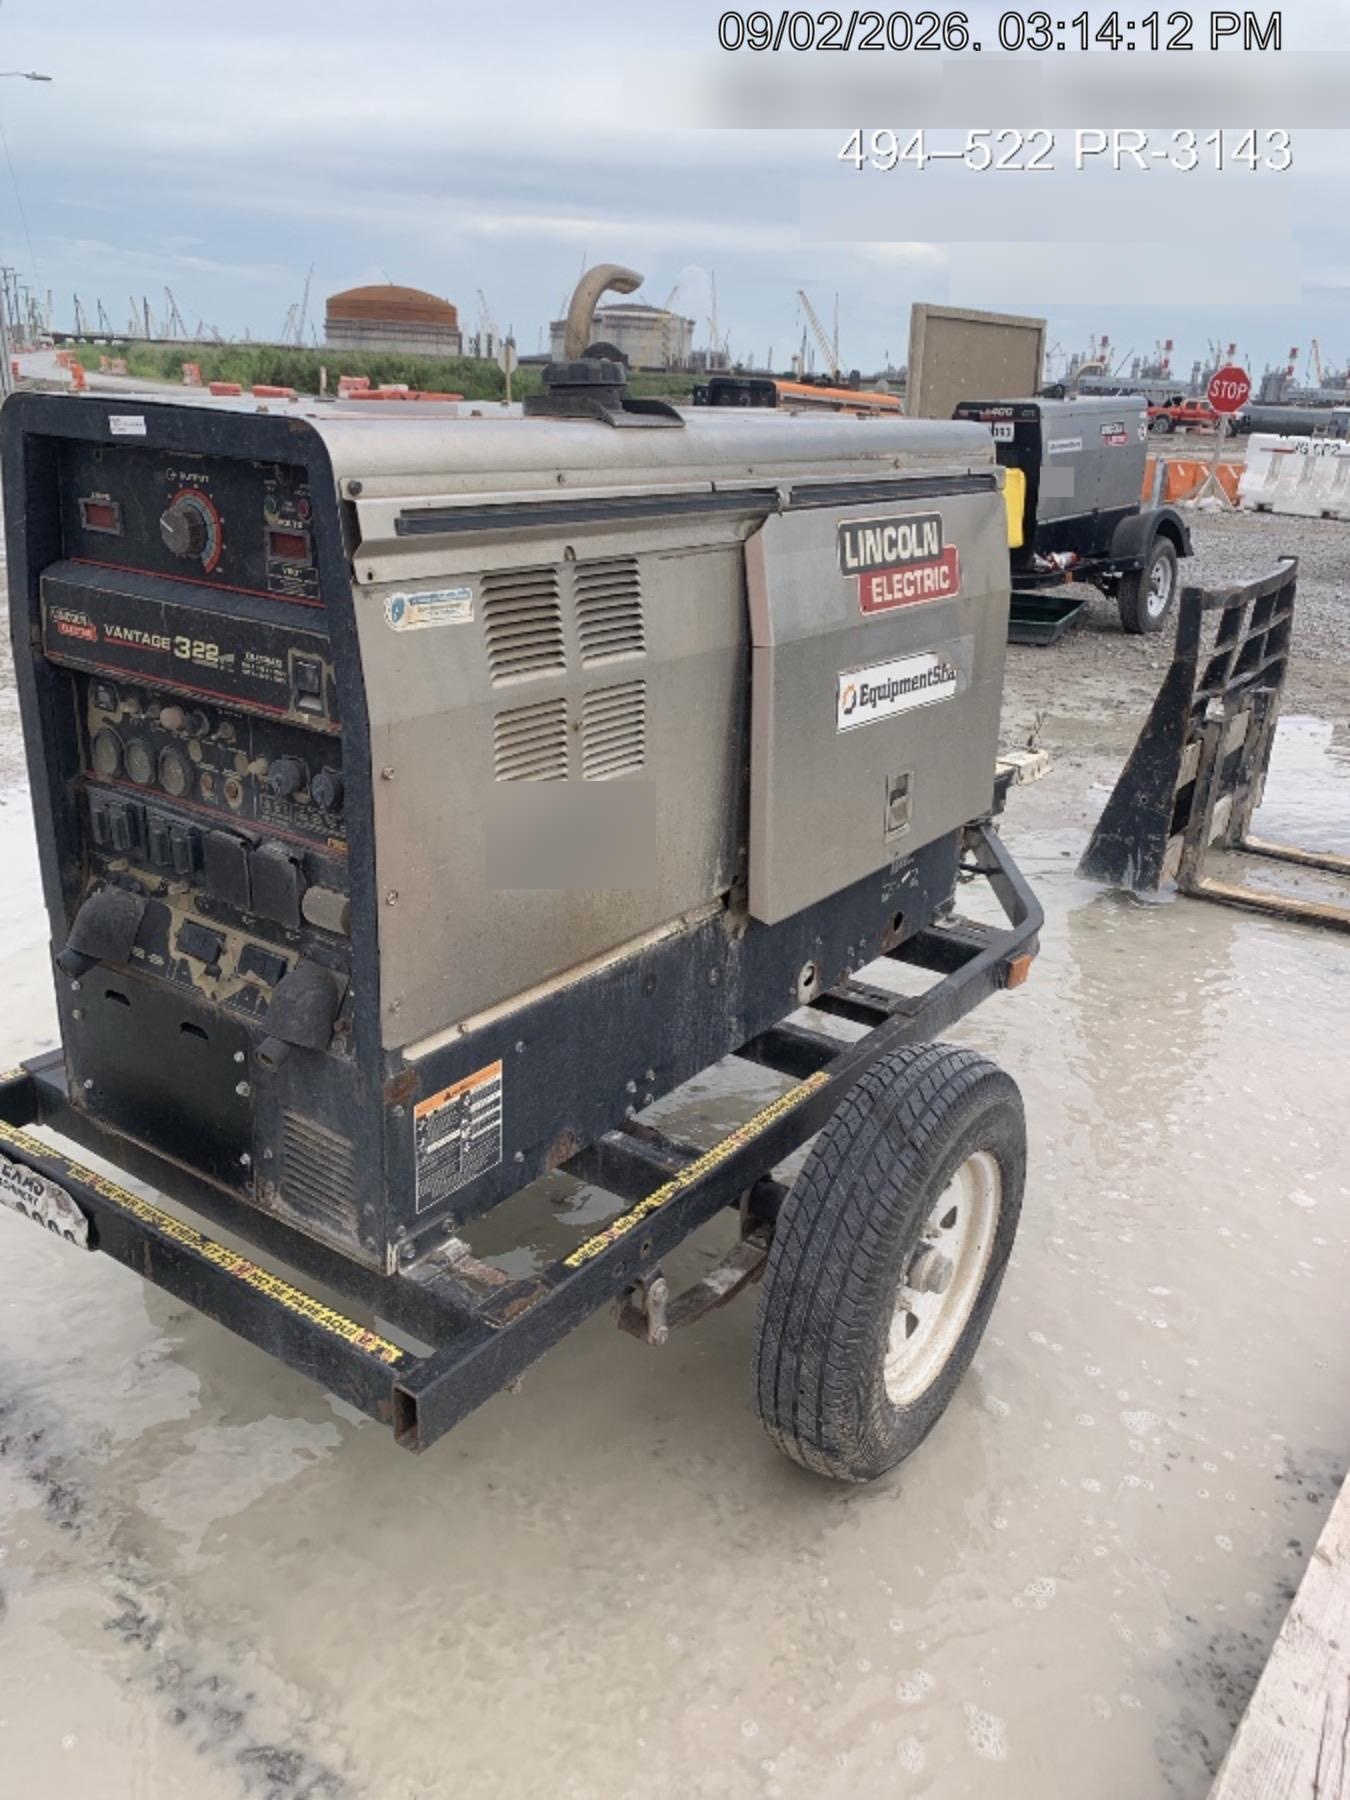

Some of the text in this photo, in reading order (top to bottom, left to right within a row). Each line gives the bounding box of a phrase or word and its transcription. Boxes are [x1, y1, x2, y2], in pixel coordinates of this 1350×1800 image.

[1210, 380, 1249, 400] STOP
[844, 521, 939, 568] LINCOLN
[871, 566, 950, 603] ELECTRIC
[104, 624, 171, 650] VANTAGE
[174, 635, 219, 663] 322
